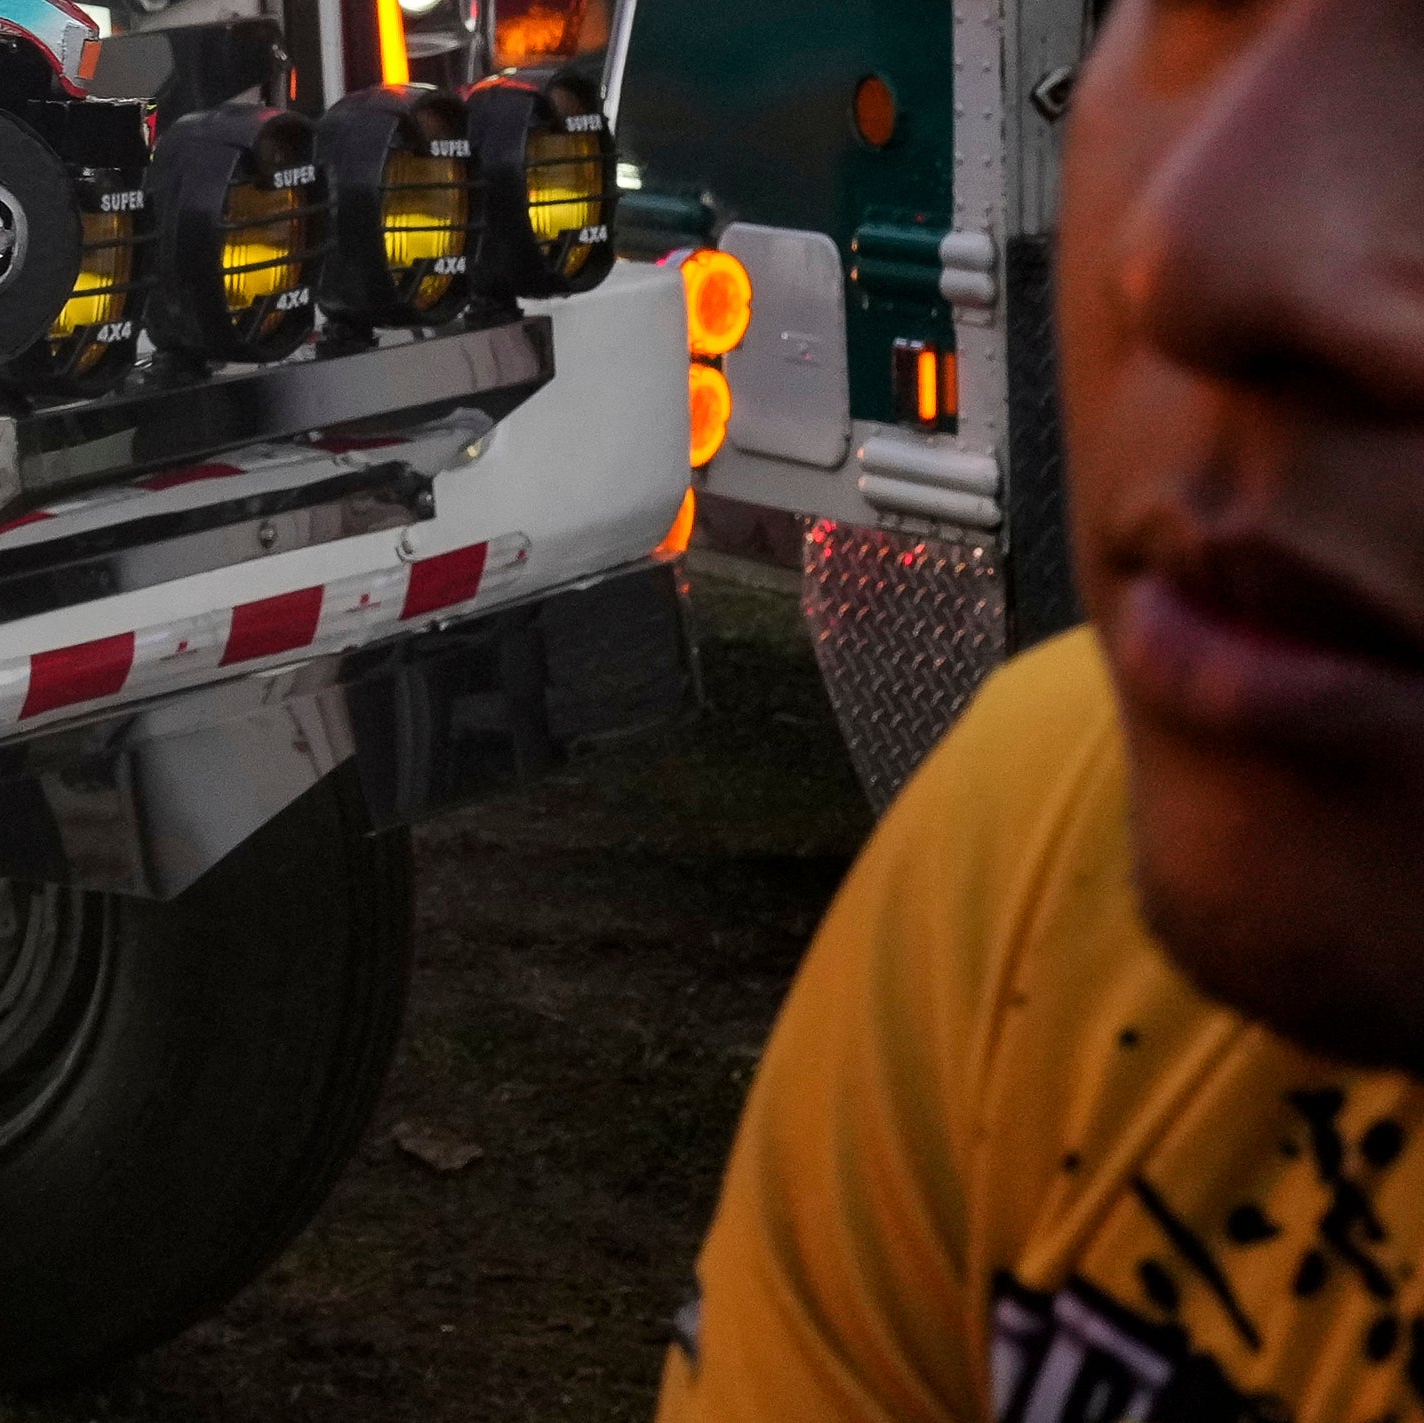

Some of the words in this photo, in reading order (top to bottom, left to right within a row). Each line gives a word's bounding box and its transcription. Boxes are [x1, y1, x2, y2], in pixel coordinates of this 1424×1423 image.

[565, 112, 603, 132] SUPER
[429, 138, 471, 158] SUPER
[273, 164, 316, 188] SUPER
[100, 190, 145, 213] SUPER
[578, 224, 608, 244] 4X4
[433, 255, 467, 276] 4X4
[275, 287, 311, 310] 4X4
[96, 321, 133, 343] 4X4
